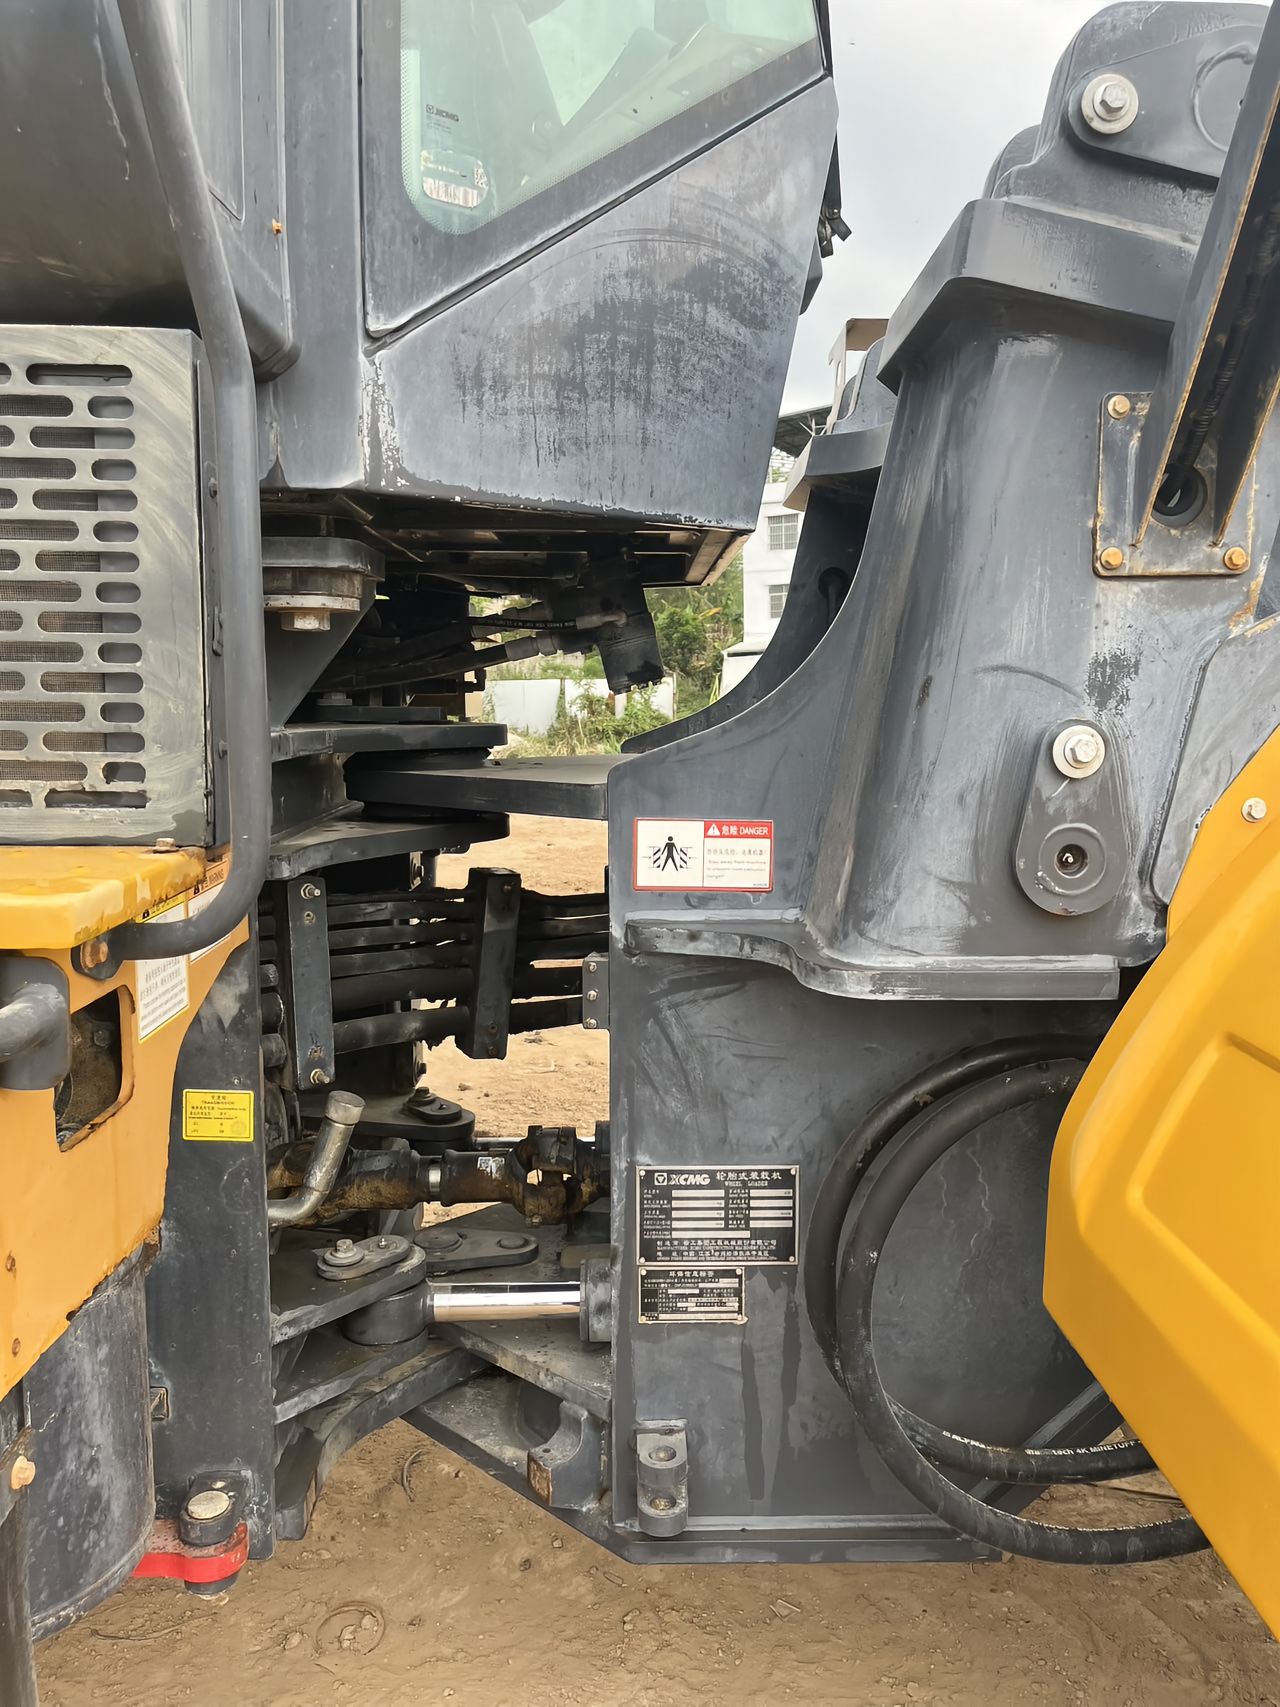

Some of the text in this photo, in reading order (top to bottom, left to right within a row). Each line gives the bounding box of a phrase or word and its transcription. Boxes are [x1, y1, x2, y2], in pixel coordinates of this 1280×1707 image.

[721, 824, 769, 836] 危险 DANGER
[668, 1173, 711, 1186] XCMG
